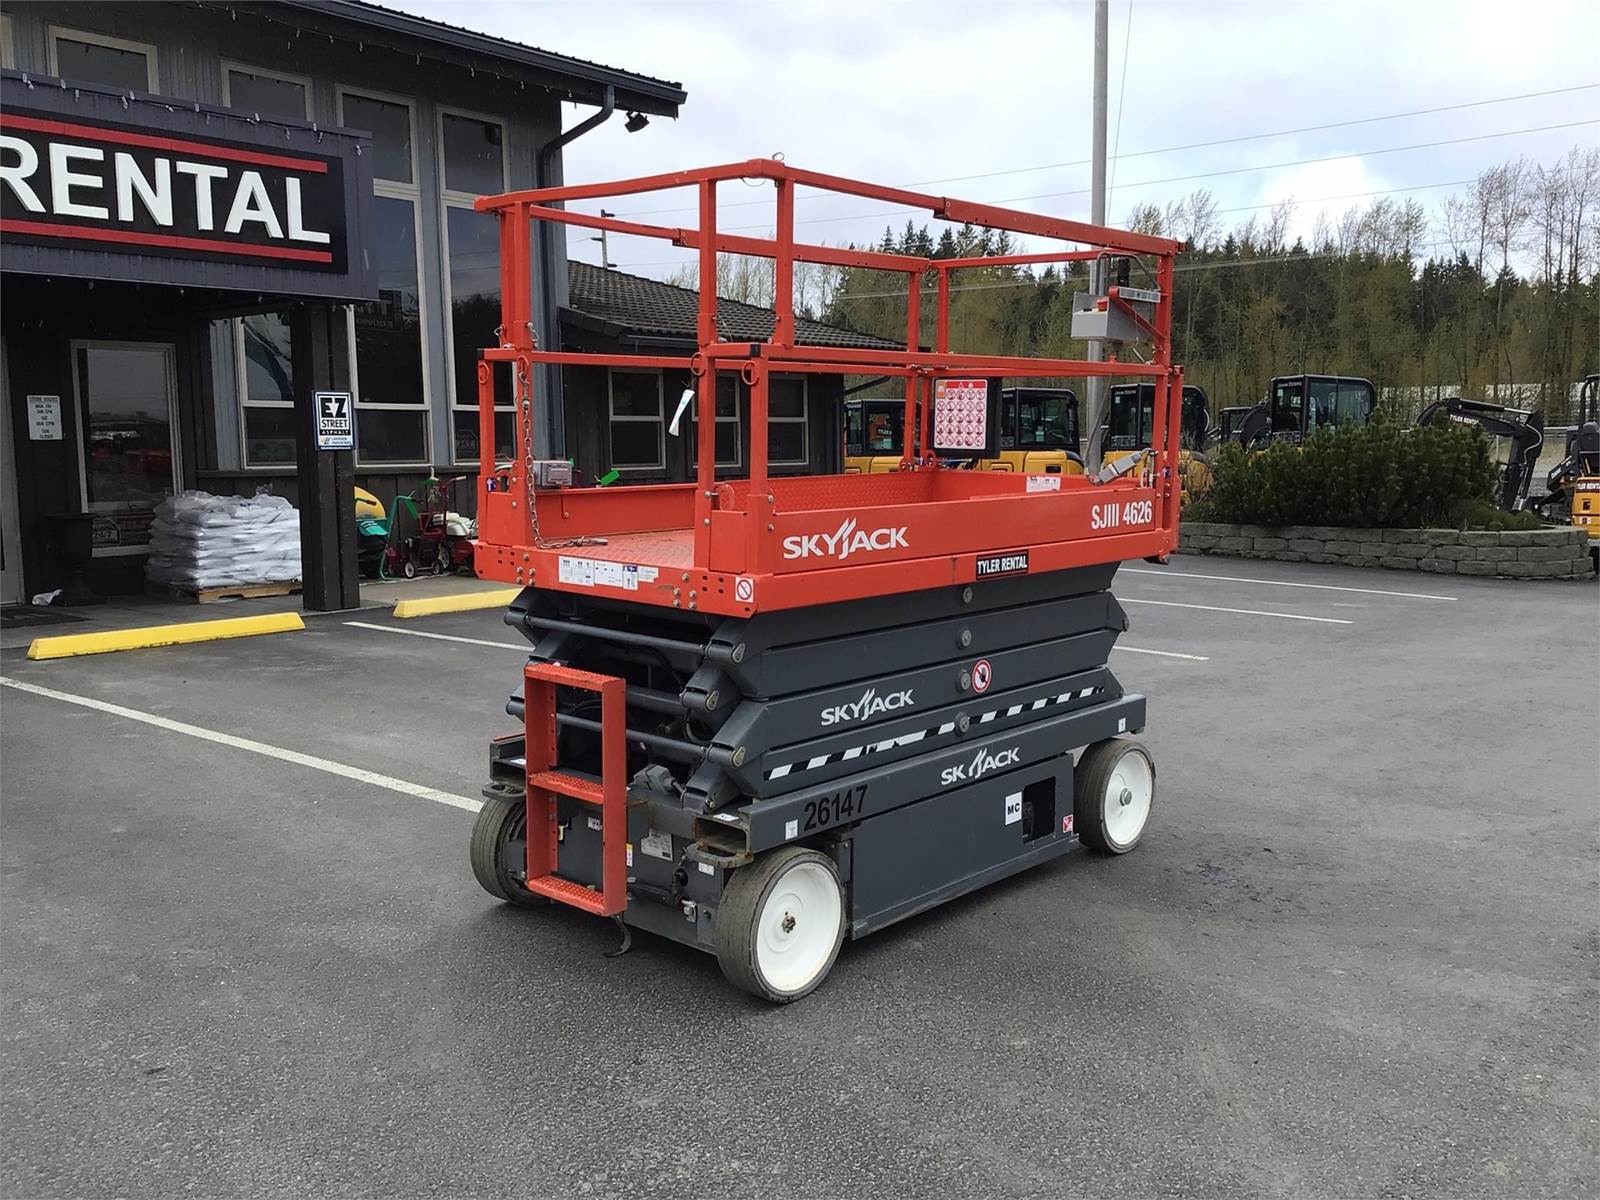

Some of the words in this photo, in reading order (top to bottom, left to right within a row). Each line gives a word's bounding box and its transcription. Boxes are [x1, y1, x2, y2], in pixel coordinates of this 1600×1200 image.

[0, 135, 331, 244] RENTAL
[321, 419, 348, 428] STREET
[1122, 500, 1152, 525] 4626
[783, 517, 910, 560] SKYJACK
[977, 559, 1000, 574] TYLER
[1001, 555, 1028, 571] RENTAL
[821, 688, 915, 726] SKYJACK
[804, 784, 868, 832] 26147
[1007, 802, 1020, 815] MC
